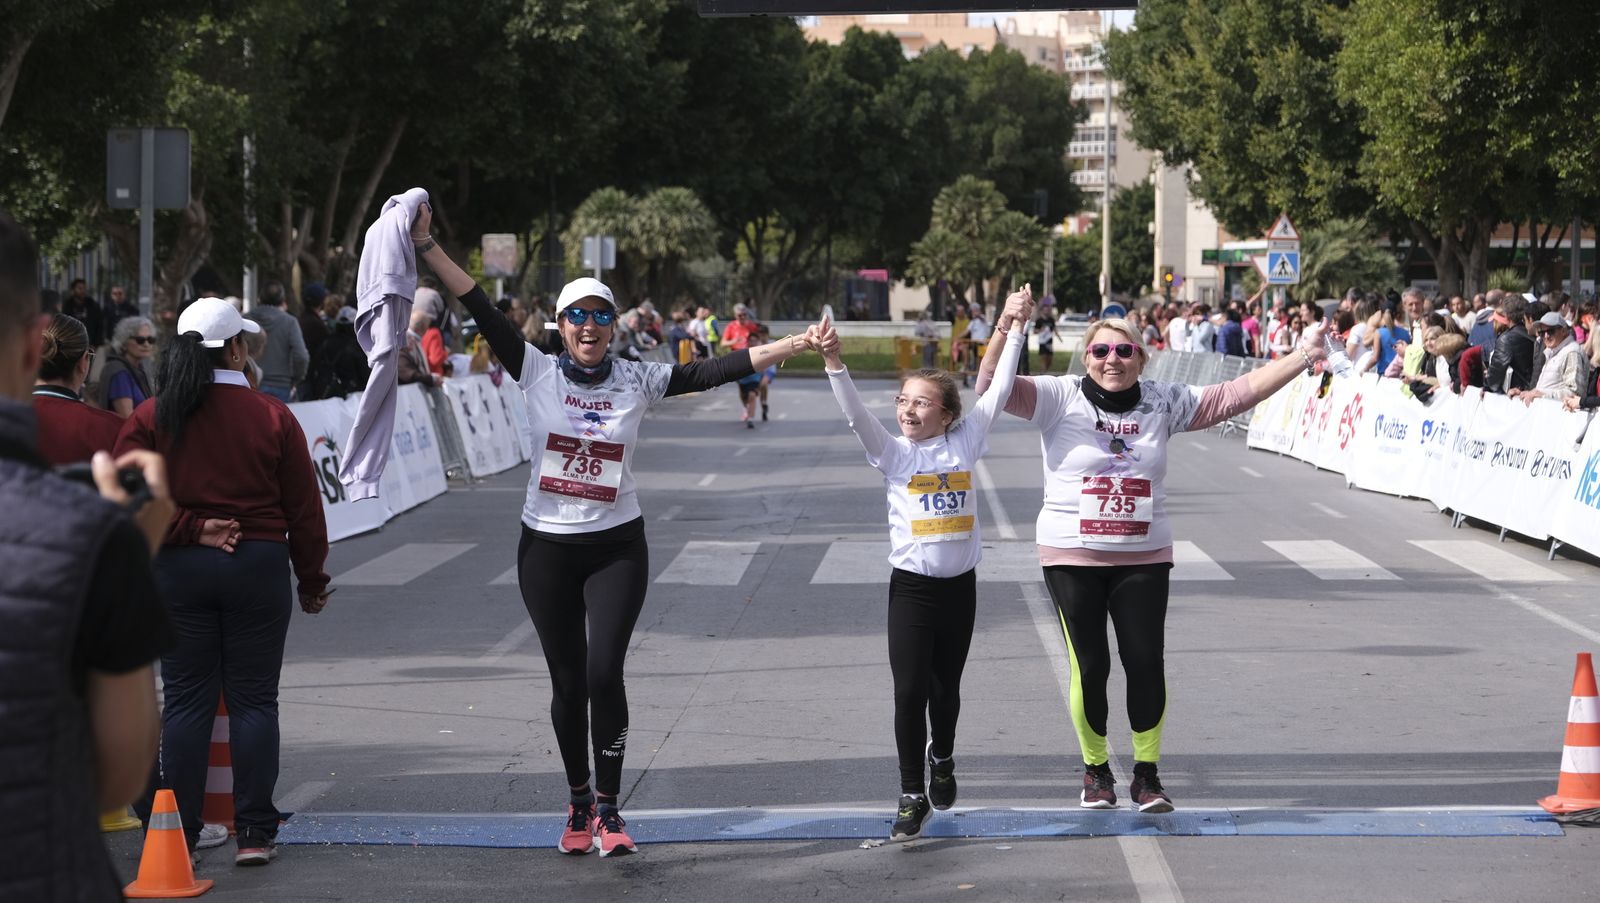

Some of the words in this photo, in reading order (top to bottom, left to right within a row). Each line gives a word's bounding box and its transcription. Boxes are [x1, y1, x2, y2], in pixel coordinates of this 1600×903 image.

[565, 394, 613, 411] MUJER
[1383, 417, 1408, 440] vithas
[562, 453, 603, 476] 736
[919, 490, 967, 512] 1637
[1097, 495, 1136, 513] 735
[602, 749, 620, 757] new
